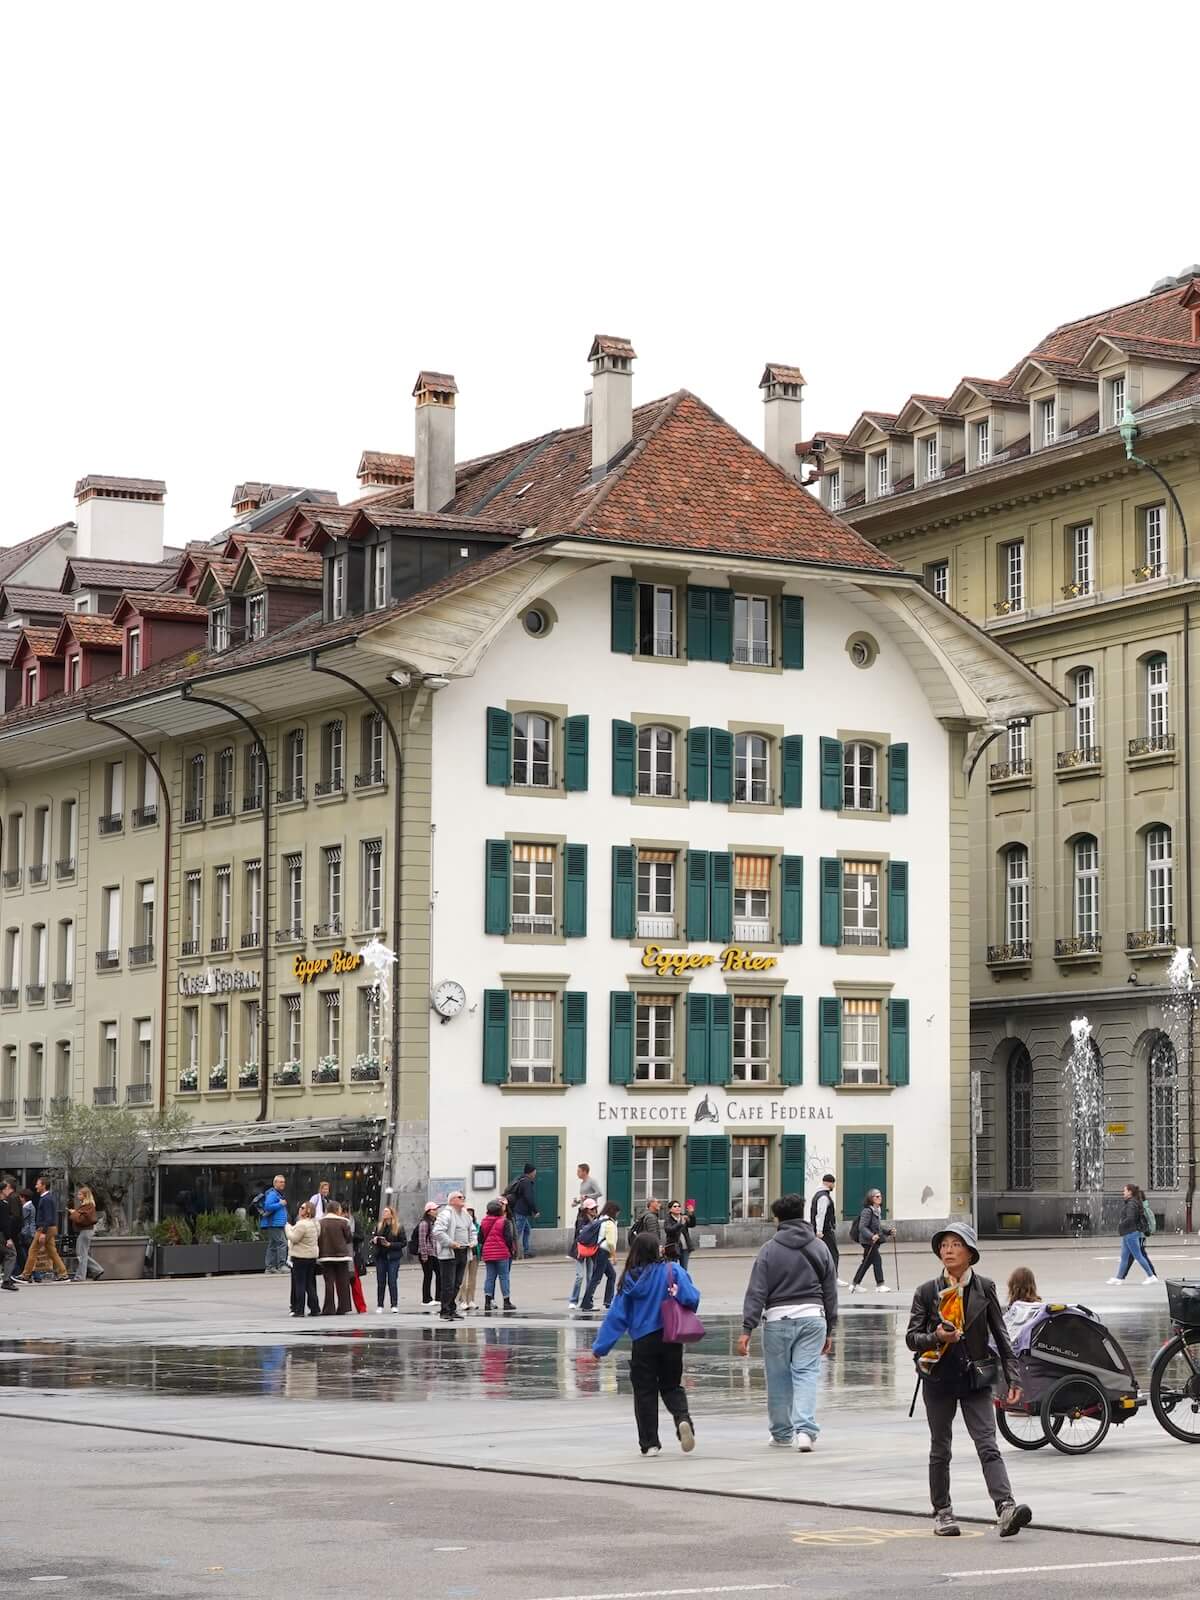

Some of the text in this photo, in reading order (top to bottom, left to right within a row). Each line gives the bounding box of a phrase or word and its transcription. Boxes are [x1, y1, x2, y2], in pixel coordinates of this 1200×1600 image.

[292, 948, 363, 985] Egger Bier
[642, 943, 778, 976] Egger Bier
[1038, 1342, 1080, 1358] BURLEY
